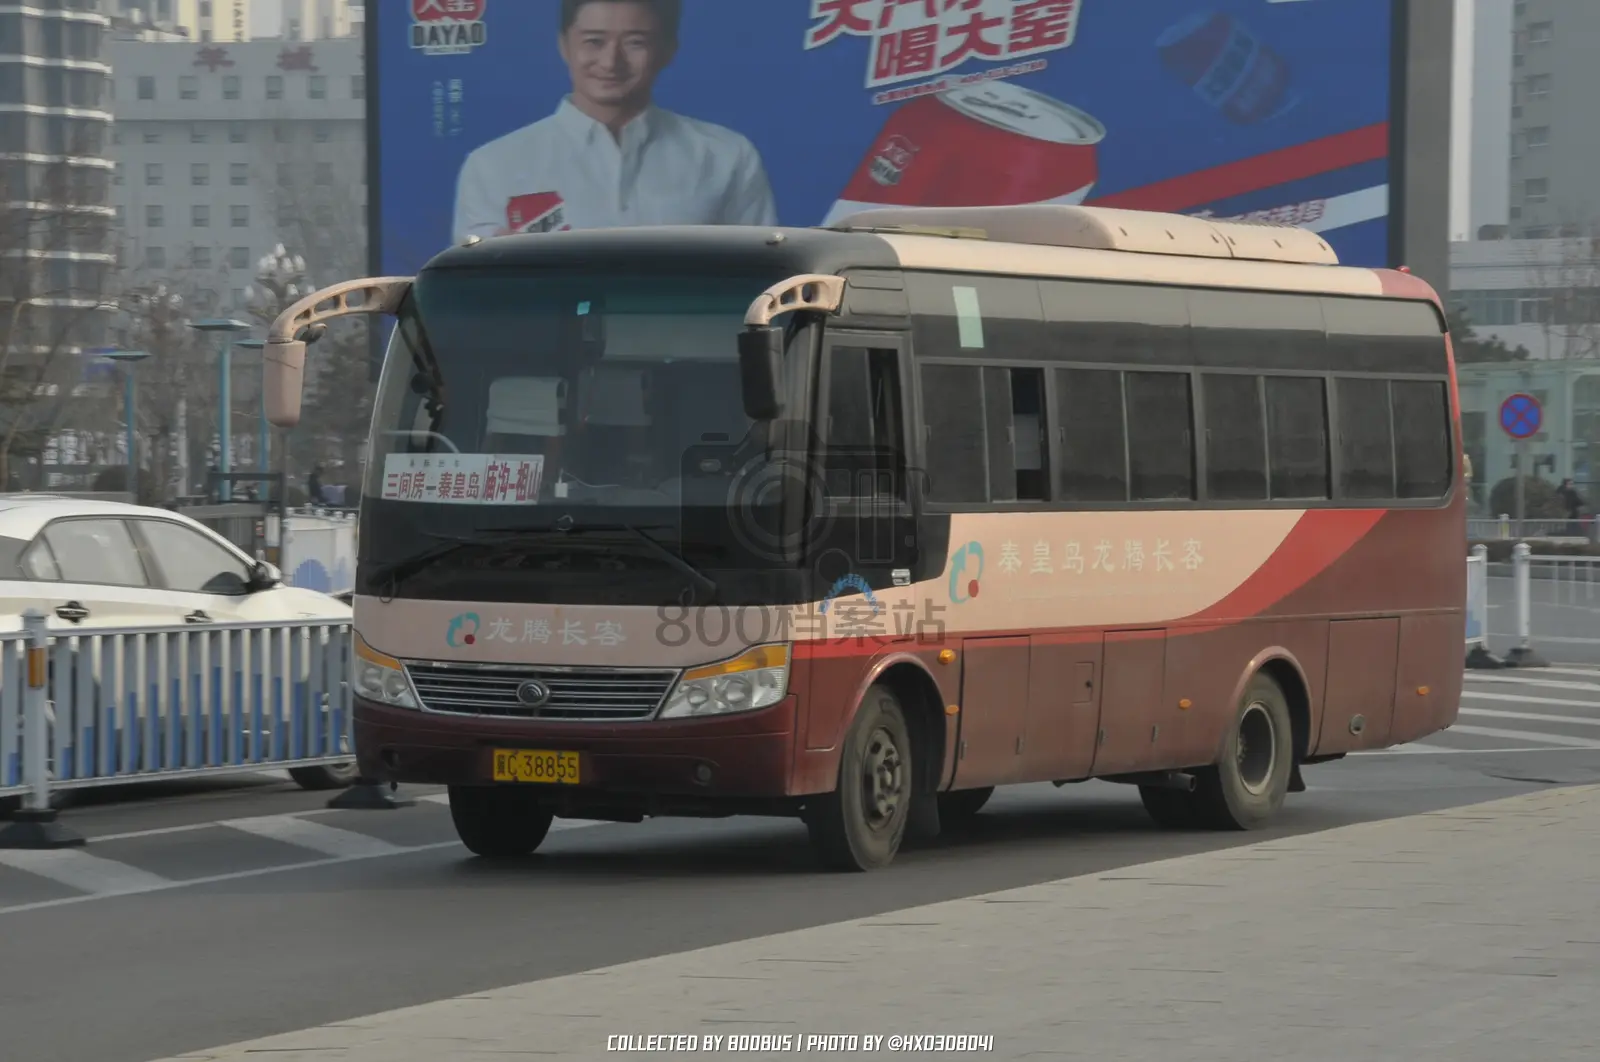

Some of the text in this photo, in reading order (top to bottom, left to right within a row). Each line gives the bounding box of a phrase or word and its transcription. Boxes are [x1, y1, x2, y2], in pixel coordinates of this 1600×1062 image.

[411, 23, 484, 46] DAYAO
[485, 615, 627, 646] 龙腾长客
